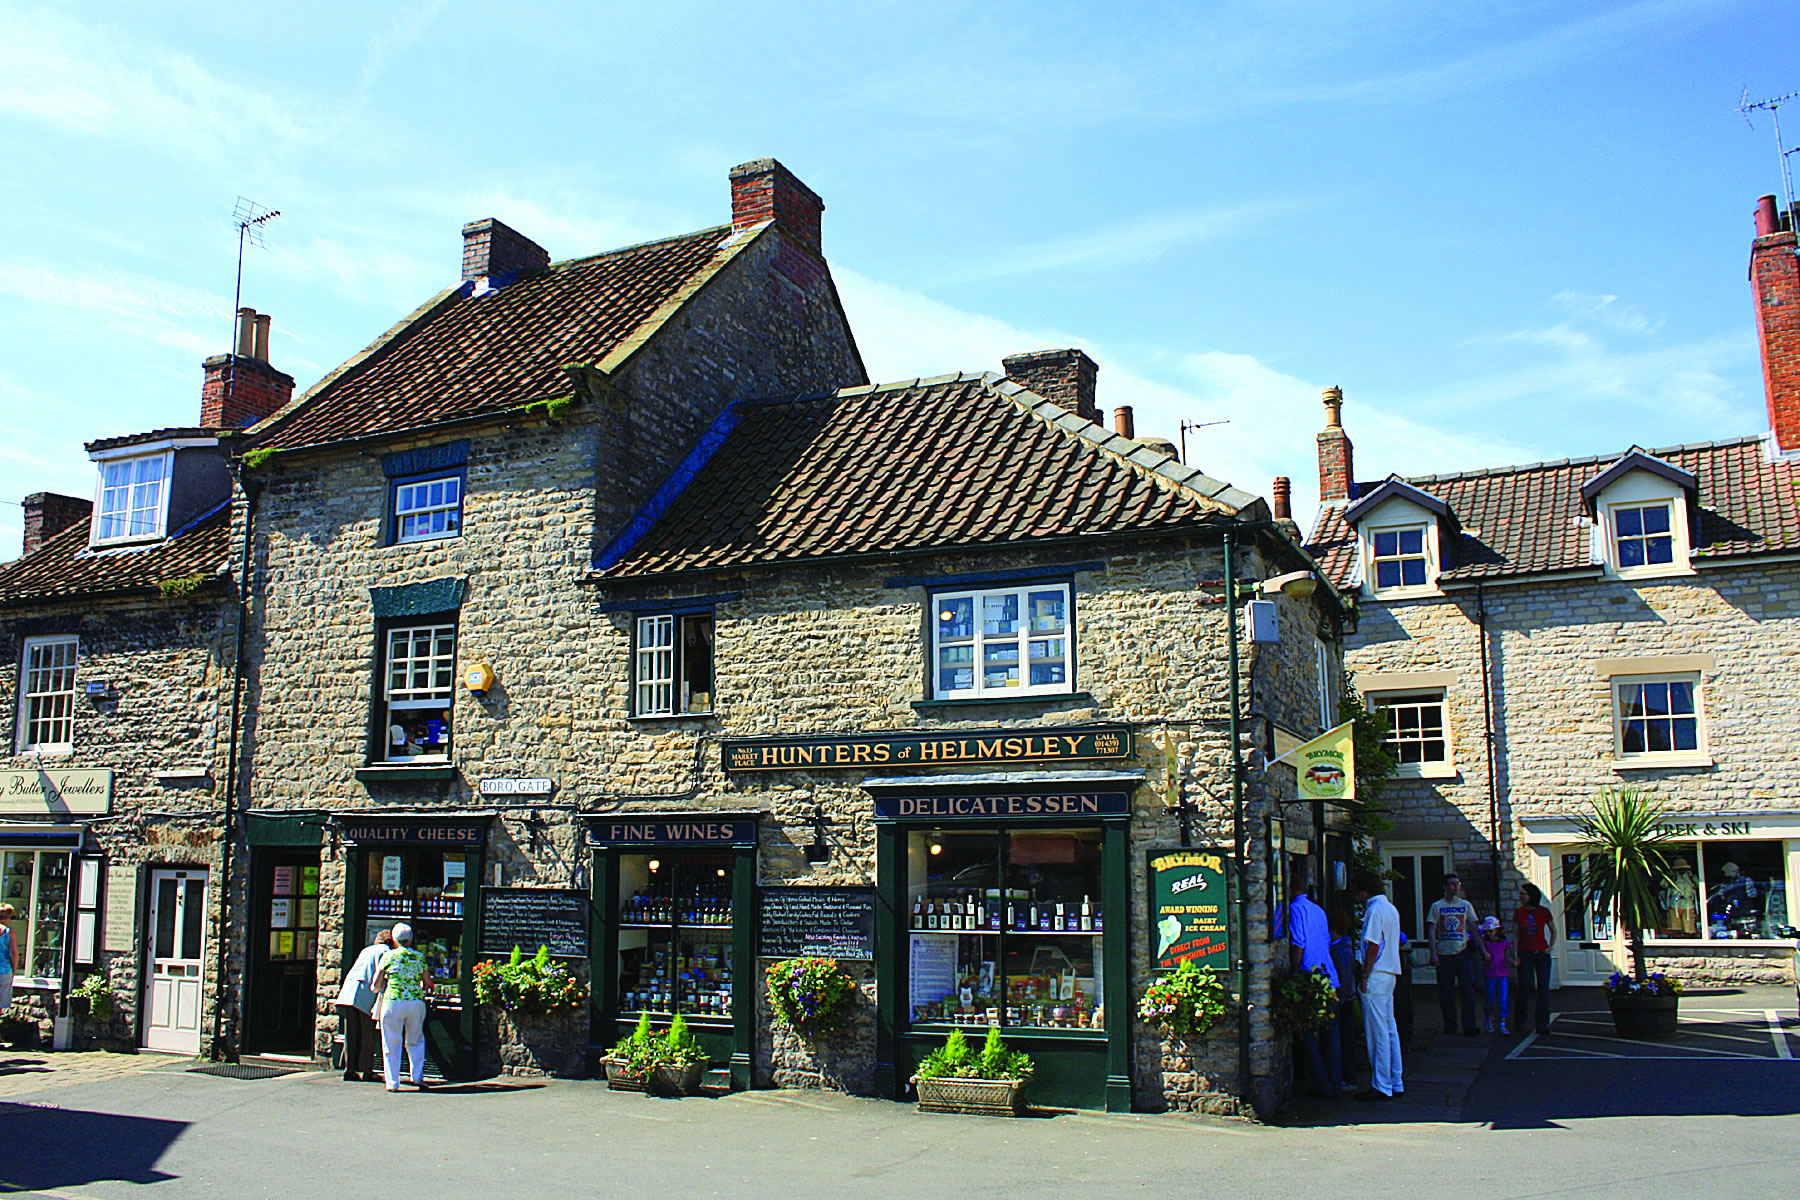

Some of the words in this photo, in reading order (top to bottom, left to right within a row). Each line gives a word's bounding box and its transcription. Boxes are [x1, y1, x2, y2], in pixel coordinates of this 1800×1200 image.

[761, 743, 891, 765] HUNTERS
[897, 746, 911, 759] of
[919, 735, 1087, 760] HELMSLEY
[1094, 739, 1120, 748] (01439)
[1305, 749, 1345, 762] BRYMOR
[8, 775, 47, 796] Butler
[47, 775, 105, 804] Jewellers
[482, 781, 513, 793] BORO
[518, 781, 550, 792] GATE
[899, 795, 1099, 815] DELICATESSEN
[349, 828, 409, 840] QUALITY
[417, 828, 477, 840] CHEESE
[610, 824, 656, 840] FINE
[665, 823, 734, 840] WINES
[1703, 822, 1718, 836] &
[1721, 821, 1752, 836] SKI
[1151, 852, 1224, 875] BRYMOR
[1171, 873, 1206, 894] REAL
[1160, 905, 1185, 914] AWARD
[1186, 905, 1219, 914] WINNING
[1169, 941, 1192, 955] DIRECT
[1192, 936, 1211, 948] FROM
[1160, 959, 1173, 968] THE
[1207, 942, 1227, 955] DALES
